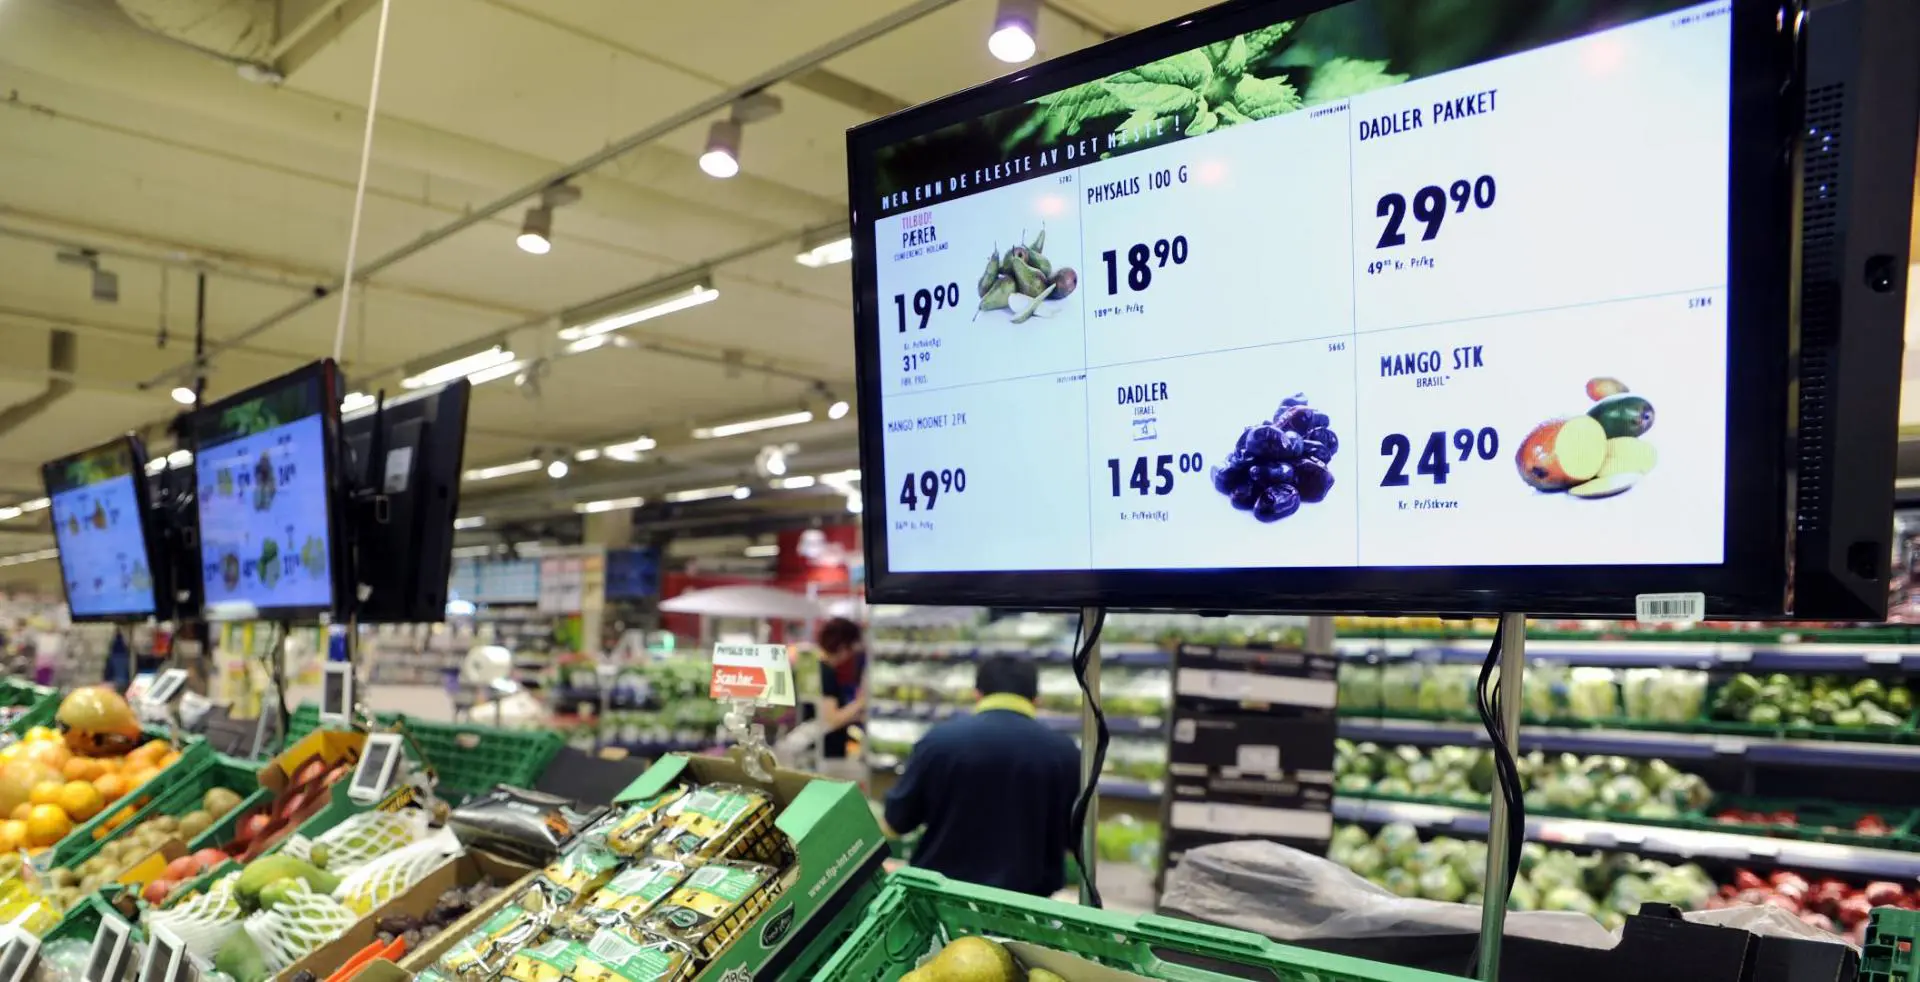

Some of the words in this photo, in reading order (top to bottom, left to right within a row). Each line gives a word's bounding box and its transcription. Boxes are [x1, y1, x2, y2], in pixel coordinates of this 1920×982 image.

[1359, 108, 1423, 141] DADLER
[1433, 88, 1498, 124] PAKKET
[882, 191, 909, 210] MER
[916, 182, 942, 201] ENN
[950, 174, 967, 192] DE
[975, 156, 1031, 185] FLESTE
[1040, 149, 1059, 167] AV
[1067, 137, 1098, 159] DET
[1108, 122, 1164, 148] MESTE
[1087, 176, 1141, 205] PHYSALIS
[1149, 169, 1171, 190] 100
[1178, 165, 1188, 183] G
[902, 211, 932, 229] TILBUD!
[903, 225, 936, 248] PÆRER
[1410, 255, 1434, 268] Pr/kg
[1380, 350, 1441, 377] MANGO
[1453, 345, 1484, 370] STK
[1117, 381, 1168, 405] DADLER
[888, 418, 914, 432] MANGO
[951, 412, 967, 426] 2PK
[1134, 405, 1156, 416] ISRAEL
[1414, 499, 1459, 510] Pr/Stkvare
